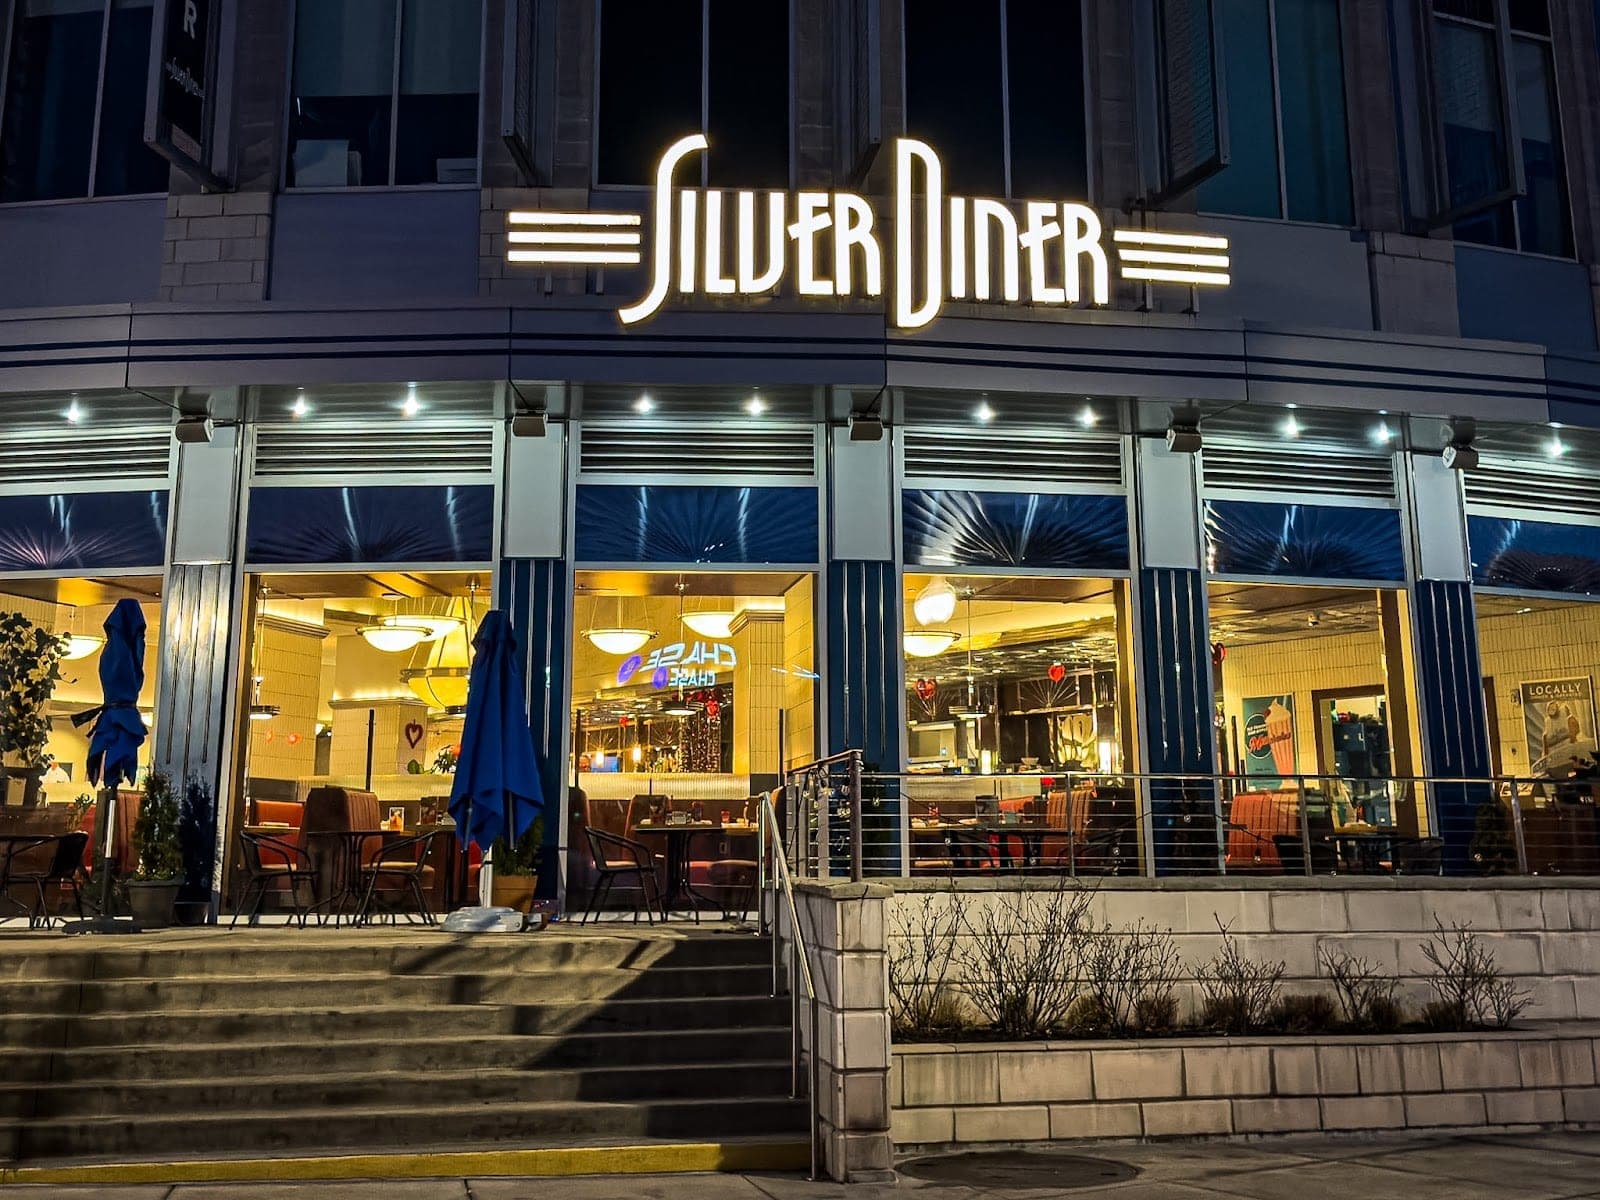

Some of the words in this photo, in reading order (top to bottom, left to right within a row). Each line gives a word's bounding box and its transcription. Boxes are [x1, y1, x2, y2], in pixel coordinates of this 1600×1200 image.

[618, 134, 881, 325] SILVER
[896, 138, 1109, 328] DINER
[1529, 683, 1581, 695] LOCALLY
